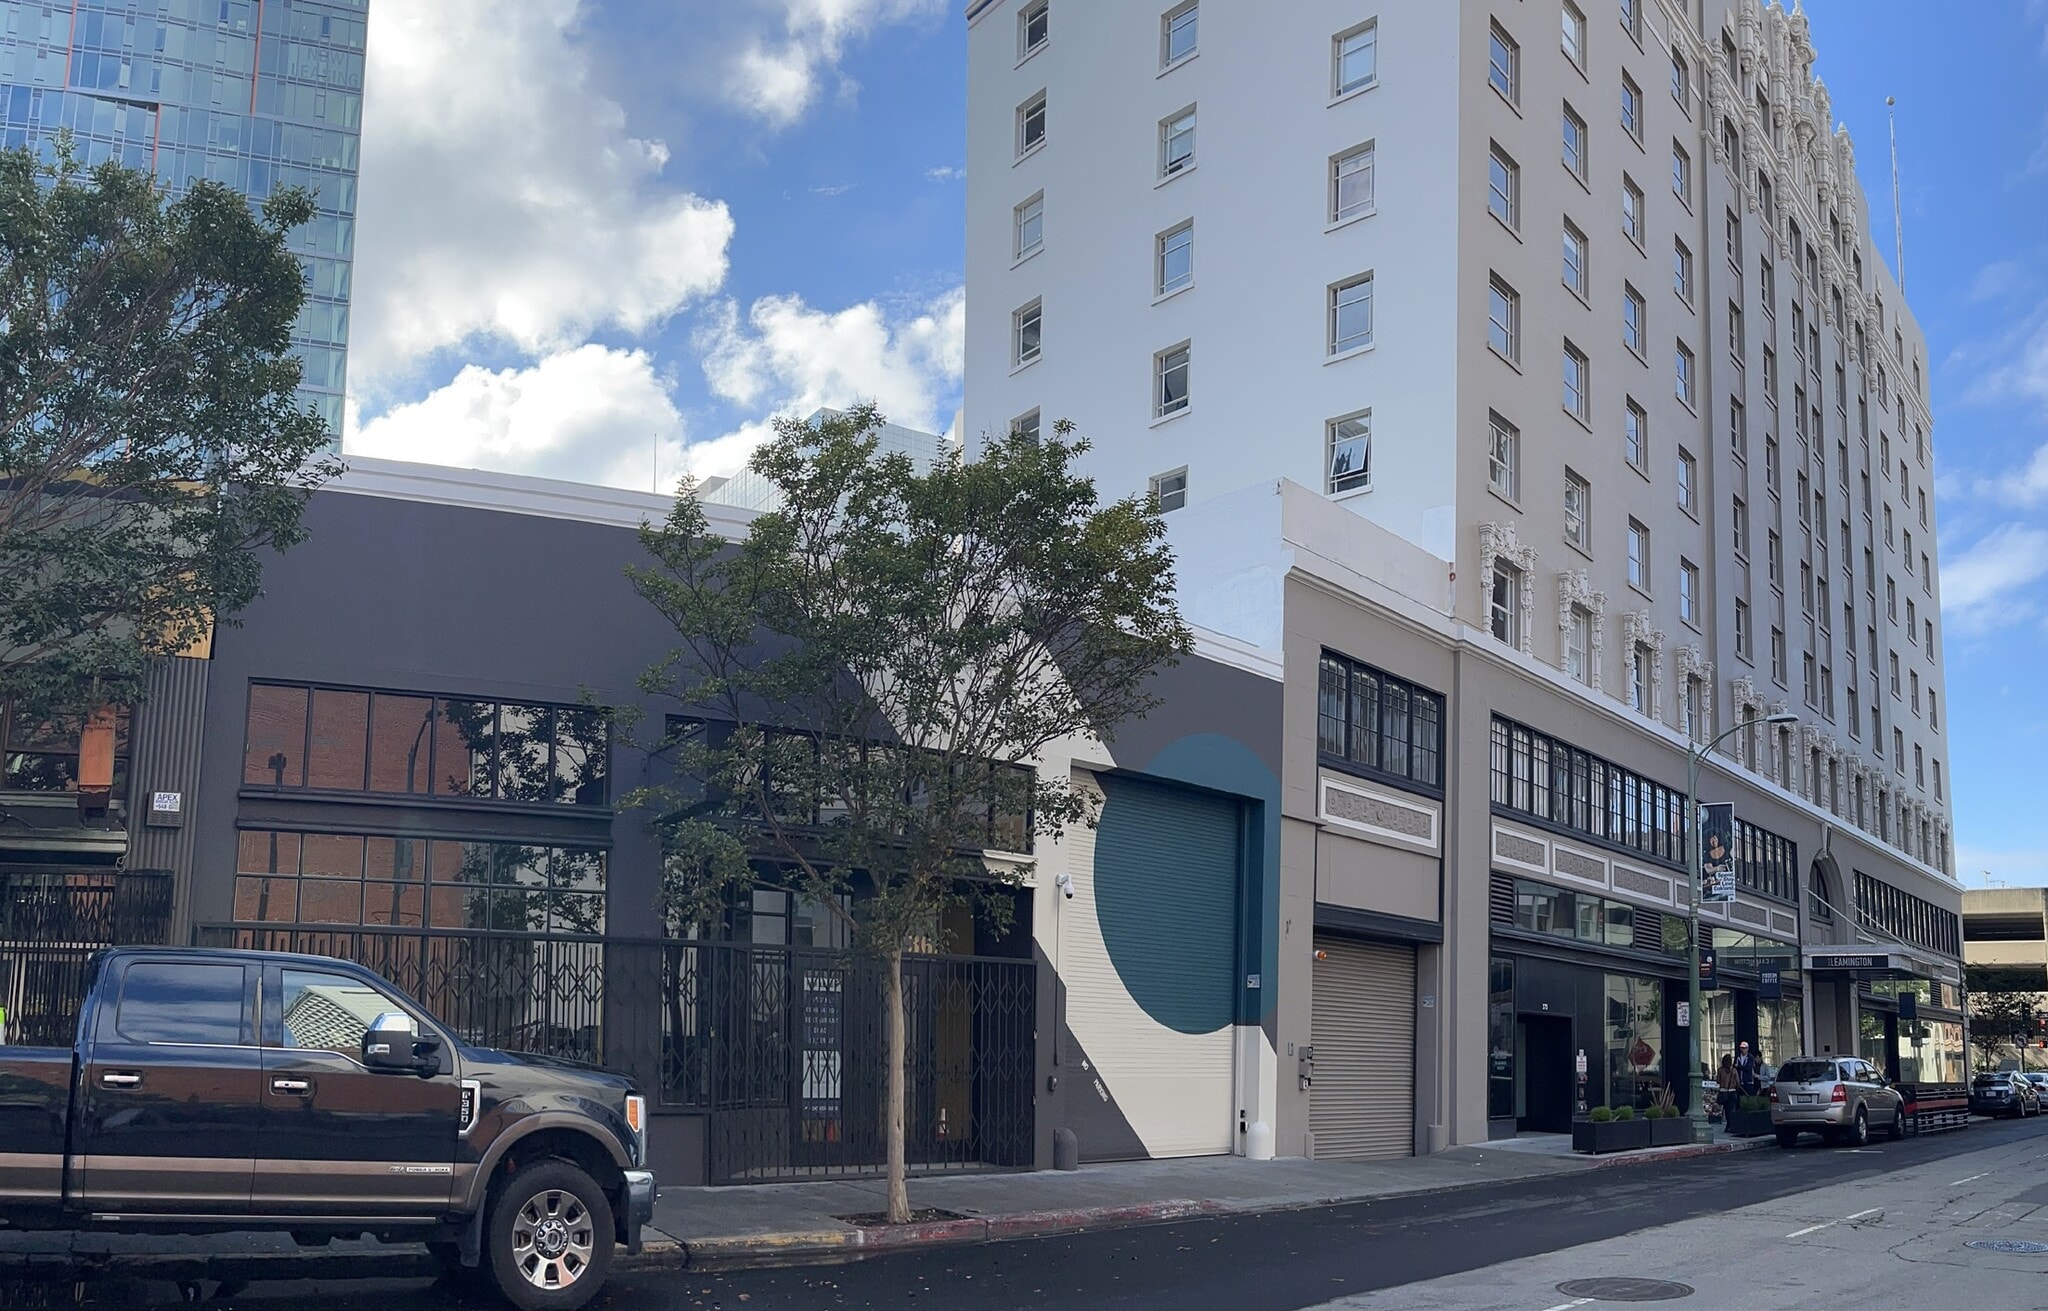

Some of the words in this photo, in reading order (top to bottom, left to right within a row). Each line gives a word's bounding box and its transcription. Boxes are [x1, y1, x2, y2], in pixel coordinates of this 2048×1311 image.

[157, 793, 178, 801] APEX
[1830, 957, 1873, 967] LEAMINGTON
[1081, 1060, 1089, 1070] NO
[1093, 1078, 1108, 1102] PARKING
